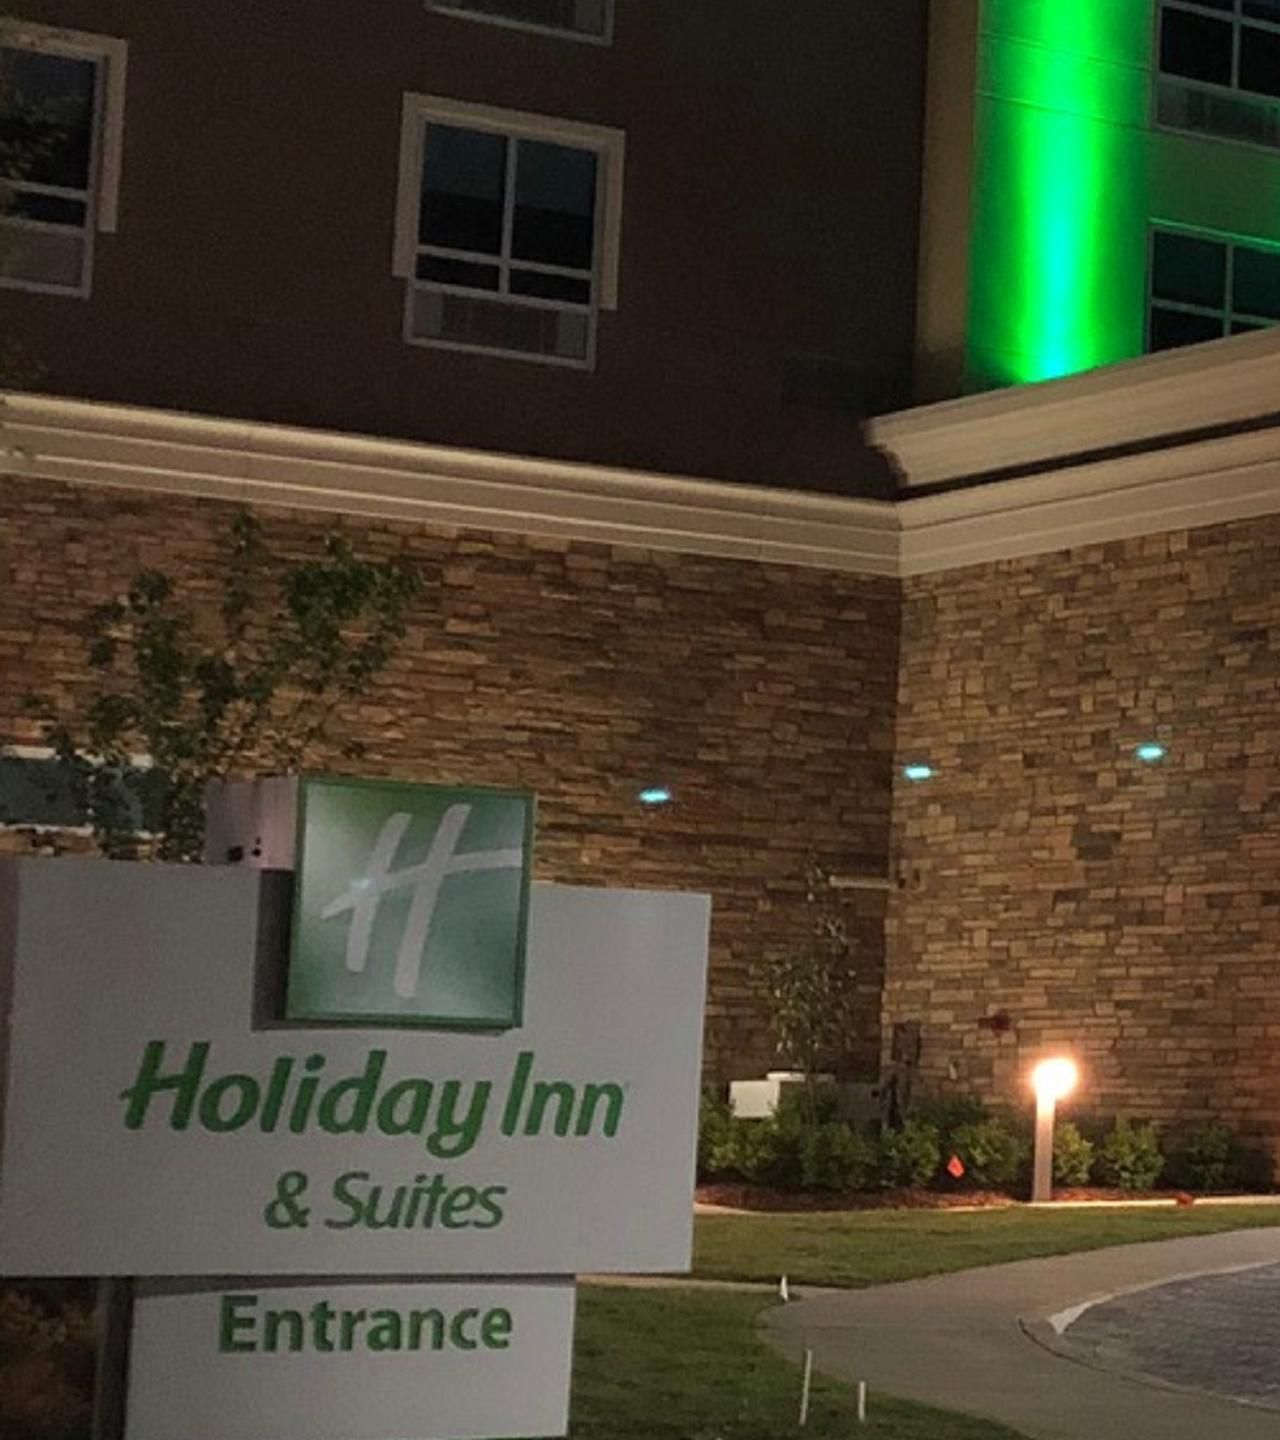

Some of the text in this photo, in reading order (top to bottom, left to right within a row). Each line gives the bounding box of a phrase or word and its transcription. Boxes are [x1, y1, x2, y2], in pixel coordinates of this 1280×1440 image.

[120, 1040, 625, 1159] Holiday Inn
[264, 1170, 508, 1230] & Suites
[218, 1295, 514, 1353] Entrance
